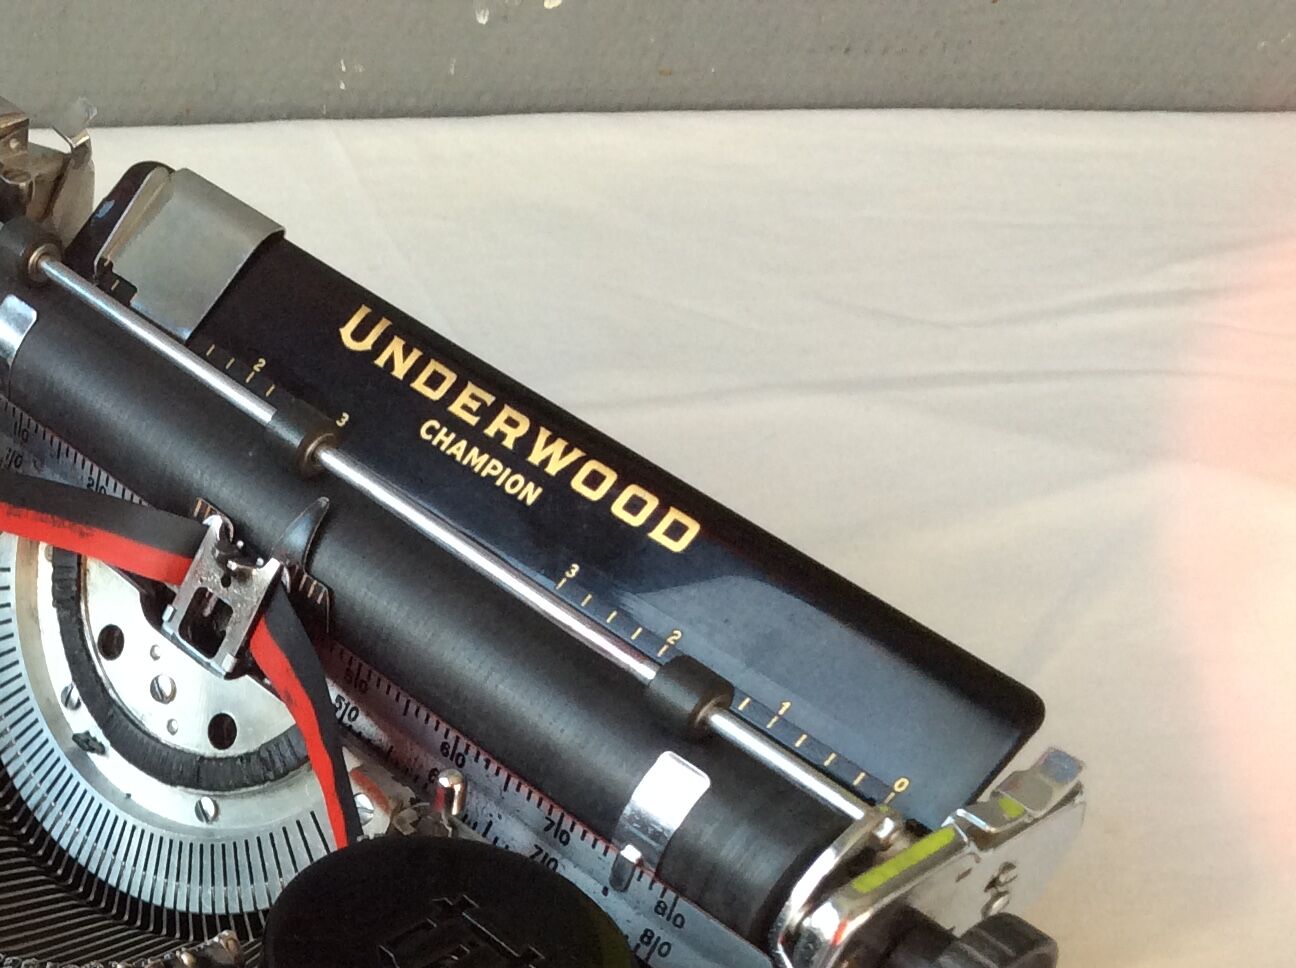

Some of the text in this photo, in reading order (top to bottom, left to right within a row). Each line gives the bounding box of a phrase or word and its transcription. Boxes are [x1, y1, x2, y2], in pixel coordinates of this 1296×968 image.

[252, 357, 267, 373] 2
[335, 411, 350, 428] 3
[339, 304, 700, 552] UNDERWOOD
[420, 418, 543, 506] CHAMPION
[565, 563, 580, 579] 3
[667, 629, 683, 646] 2
[893, 777, 910, 794] 0
